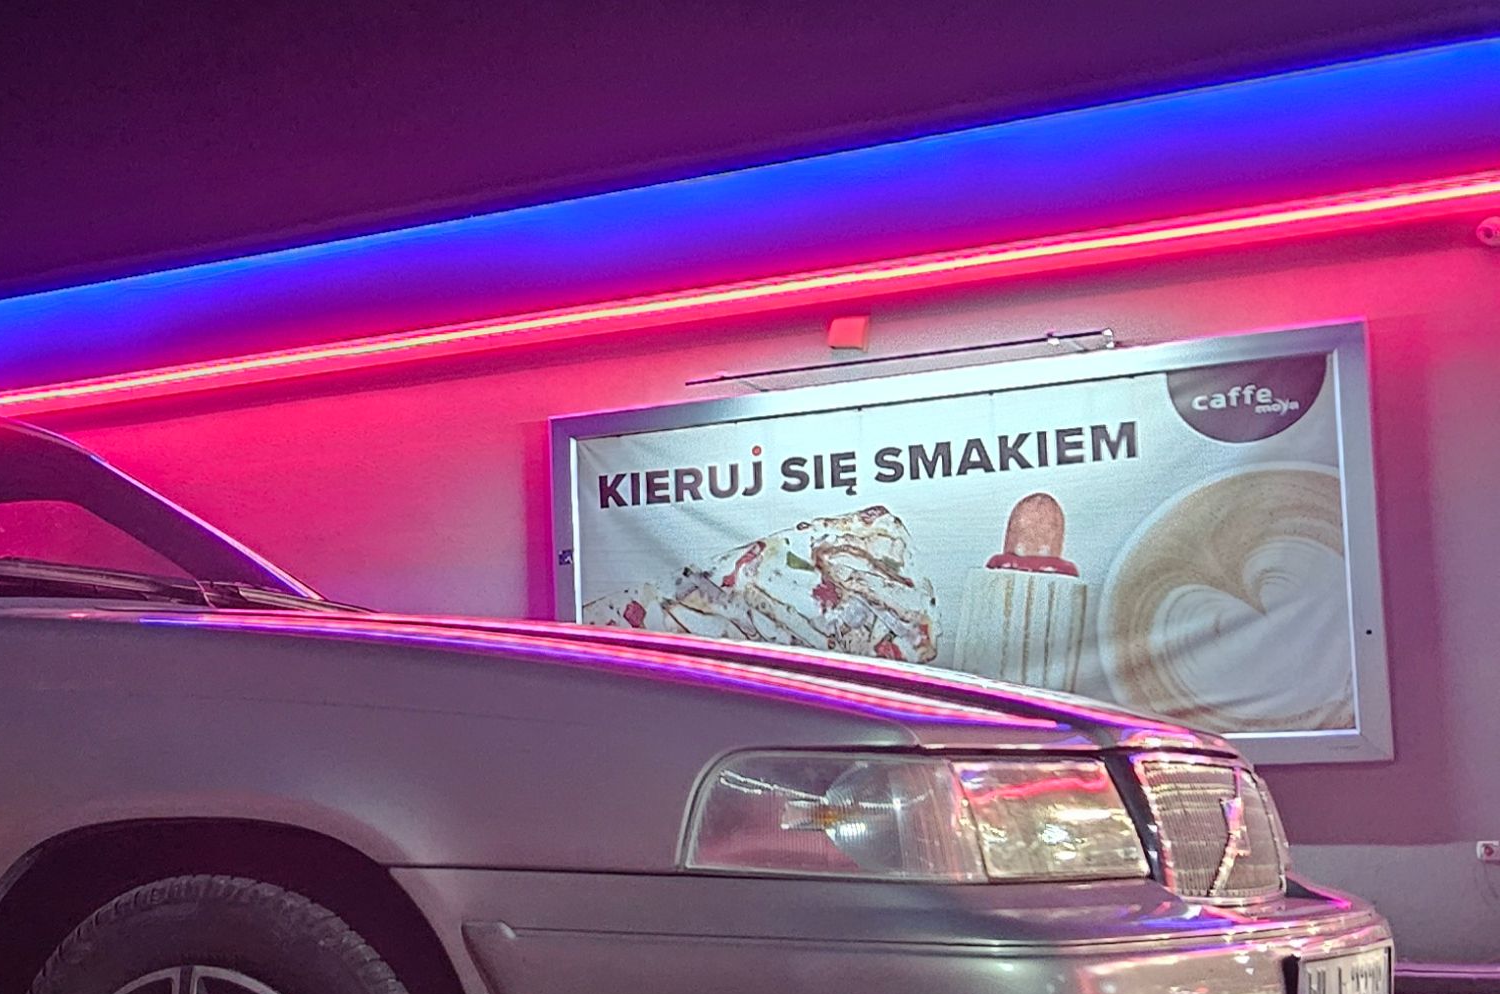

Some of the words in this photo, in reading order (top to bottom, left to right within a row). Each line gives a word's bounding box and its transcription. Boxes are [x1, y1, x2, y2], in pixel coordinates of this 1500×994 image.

[1191, 384, 1273, 411] caffe
[1254, 398, 1299, 416] moya
[780, 451, 858, 496] SIĘ
[874, 421, 1138, 483] SMAKIEM
